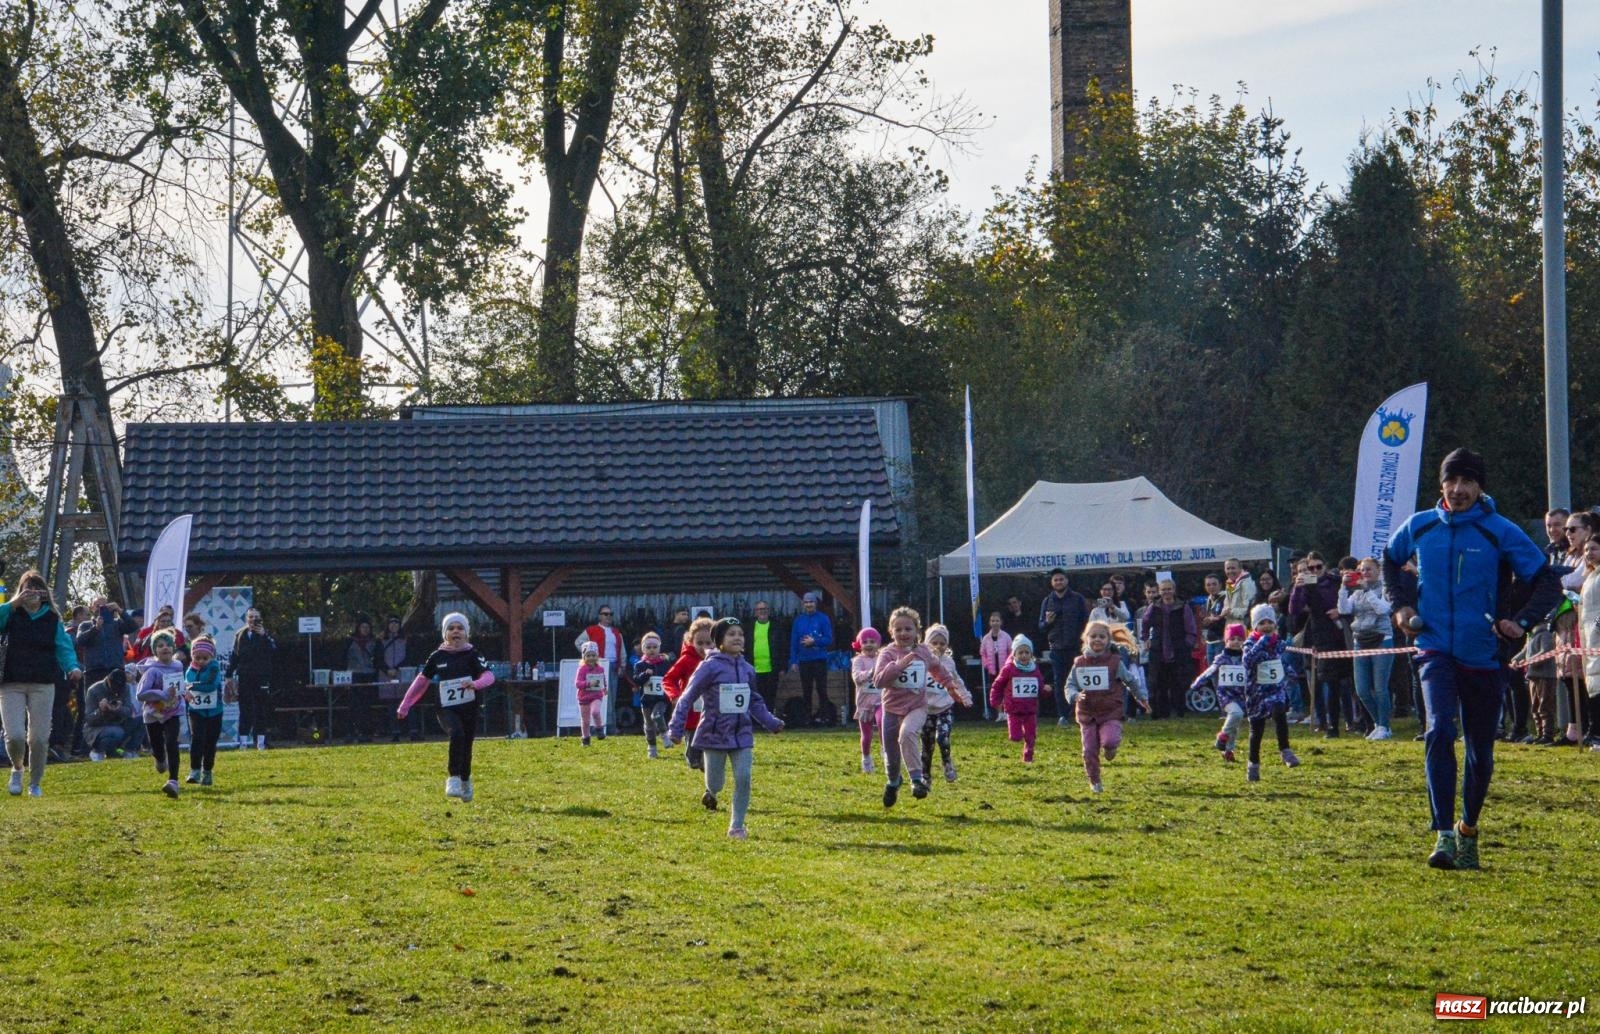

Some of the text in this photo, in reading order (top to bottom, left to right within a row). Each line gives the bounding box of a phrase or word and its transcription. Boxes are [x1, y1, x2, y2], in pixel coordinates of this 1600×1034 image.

[1378, 452, 1399, 502] STOWARZYSZENIE
[1374, 503, 1393, 529] AKTYWNI
[1372, 531, 1390, 543] DLA
[996, 547, 1216, 569] STOWARZYSZENIE AKTYWNI DLA LEPSZEGO JUTRA
[899, 671, 917, 683] 61
[1083, 675, 1101, 686] 30
[1221, 673, 1244, 682] 116
[1269, 669, 1277, 680] 5
[447, 687, 466, 701] 27
[1015, 685, 1037, 694] 122
[194, 695, 211, 705] 34
[735, 694, 745, 707] 9
